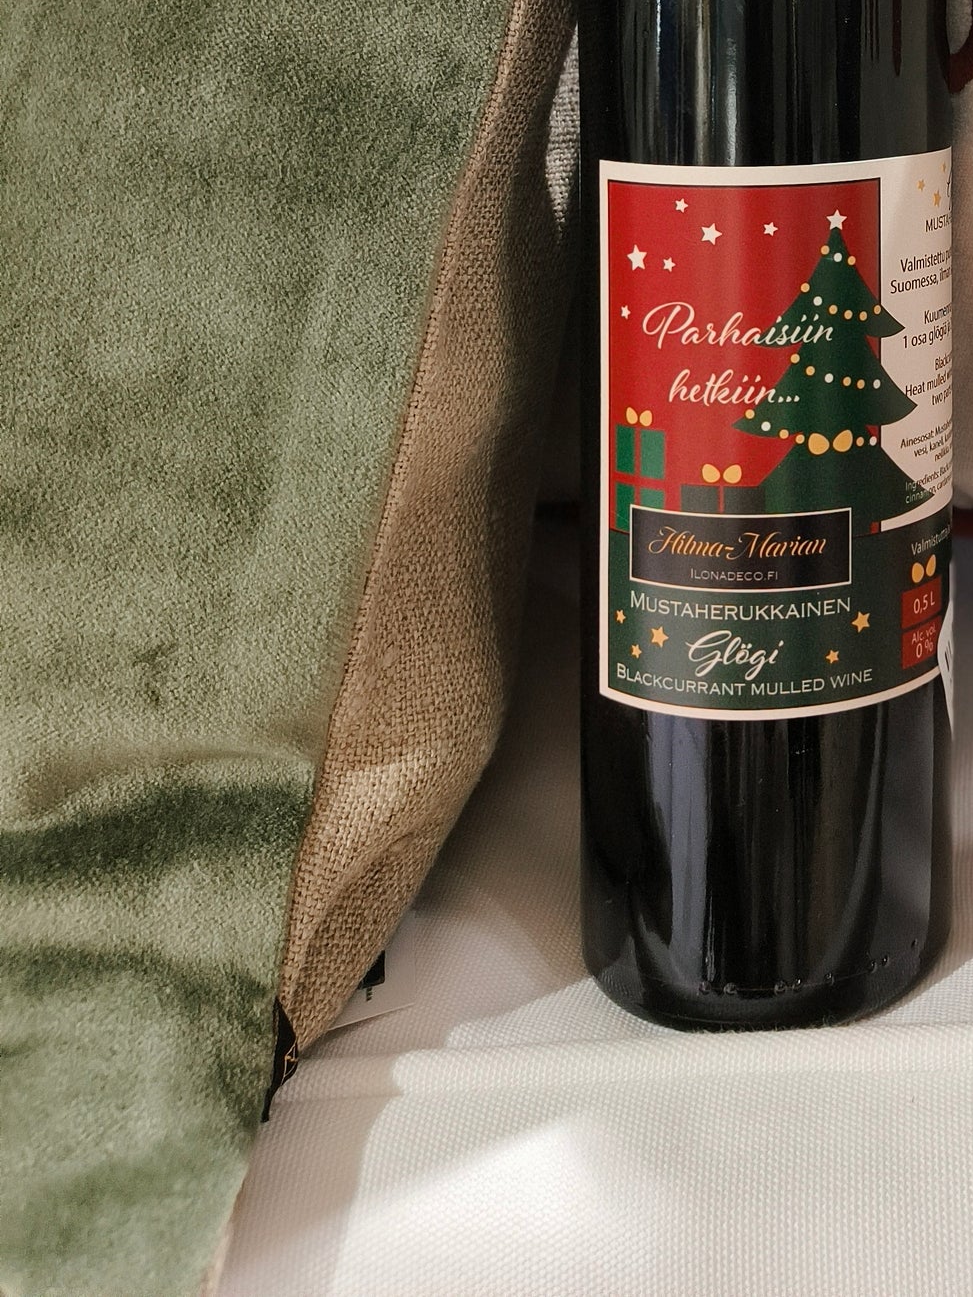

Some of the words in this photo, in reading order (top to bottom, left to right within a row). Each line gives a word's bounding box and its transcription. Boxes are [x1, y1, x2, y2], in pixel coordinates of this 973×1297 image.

[890, 273, 939, 294] Suomessa,
[642, 302, 834, 350] Parhaisiin
[903, 335, 908, 349] 1
[911, 333, 927, 347] osa
[669, 369, 800, 406] hetkiin...
[905, 382, 925, 397] Heat
[648, 526, 827, 561] Hilma-Marian
[630, 590, 851, 621] MUSTAHERUKKAINEN
[913, 593, 929, 614] 0,5
[930, 590, 935, 606] L
[685, 630, 784, 681] Glögi
[916, 643, 923, 659] 0
[925, 637, 934, 654] %
[616, 663, 746, 696] BLACKCURRANT
[751, 677, 825, 696] MULLED
[830, 668, 873, 689] WINE
